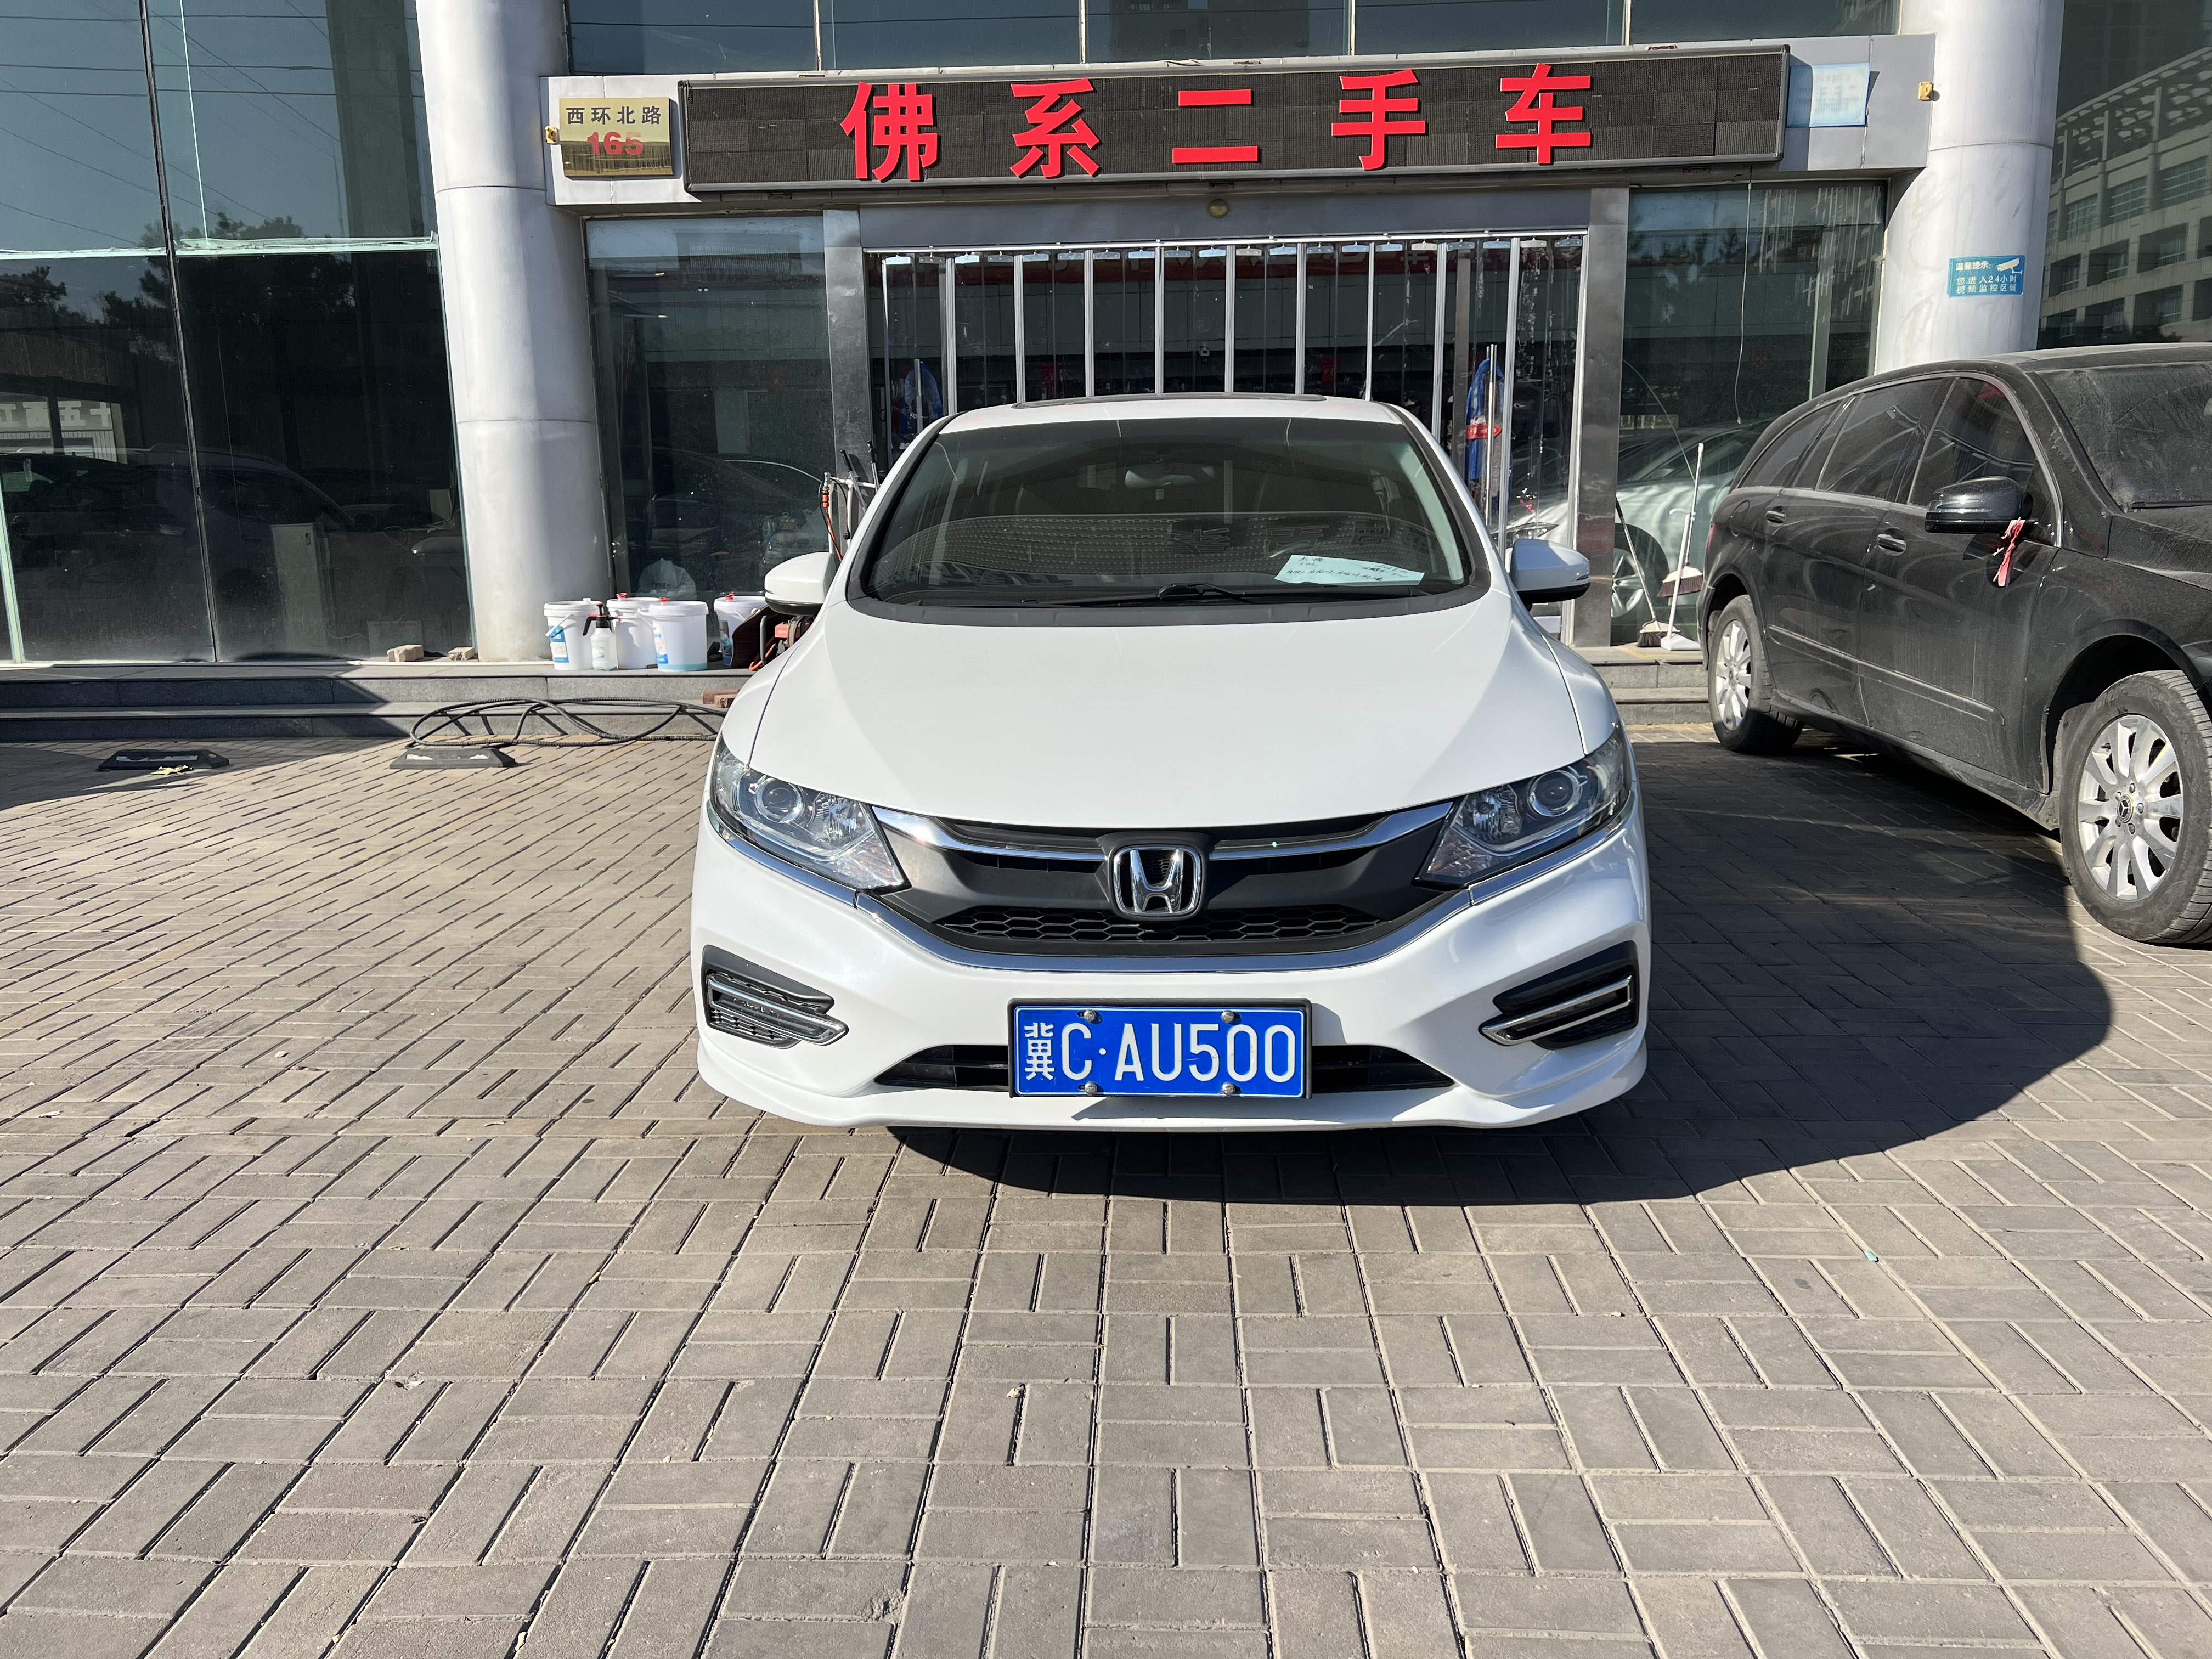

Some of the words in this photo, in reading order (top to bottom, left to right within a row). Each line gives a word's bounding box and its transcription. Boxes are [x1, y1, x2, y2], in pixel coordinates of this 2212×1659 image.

[566, 105, 661, 125] 西环北路
[840, 63, 1590, 180] 佛系二手车
[586, 132, 644, 155] 165
[1956, 274, 2017, 285] 您进入24小时
[1956, 283, 2017, 294] 视频监控区域
[1024, 1021, 1296, 1082] 冀C·AU500
